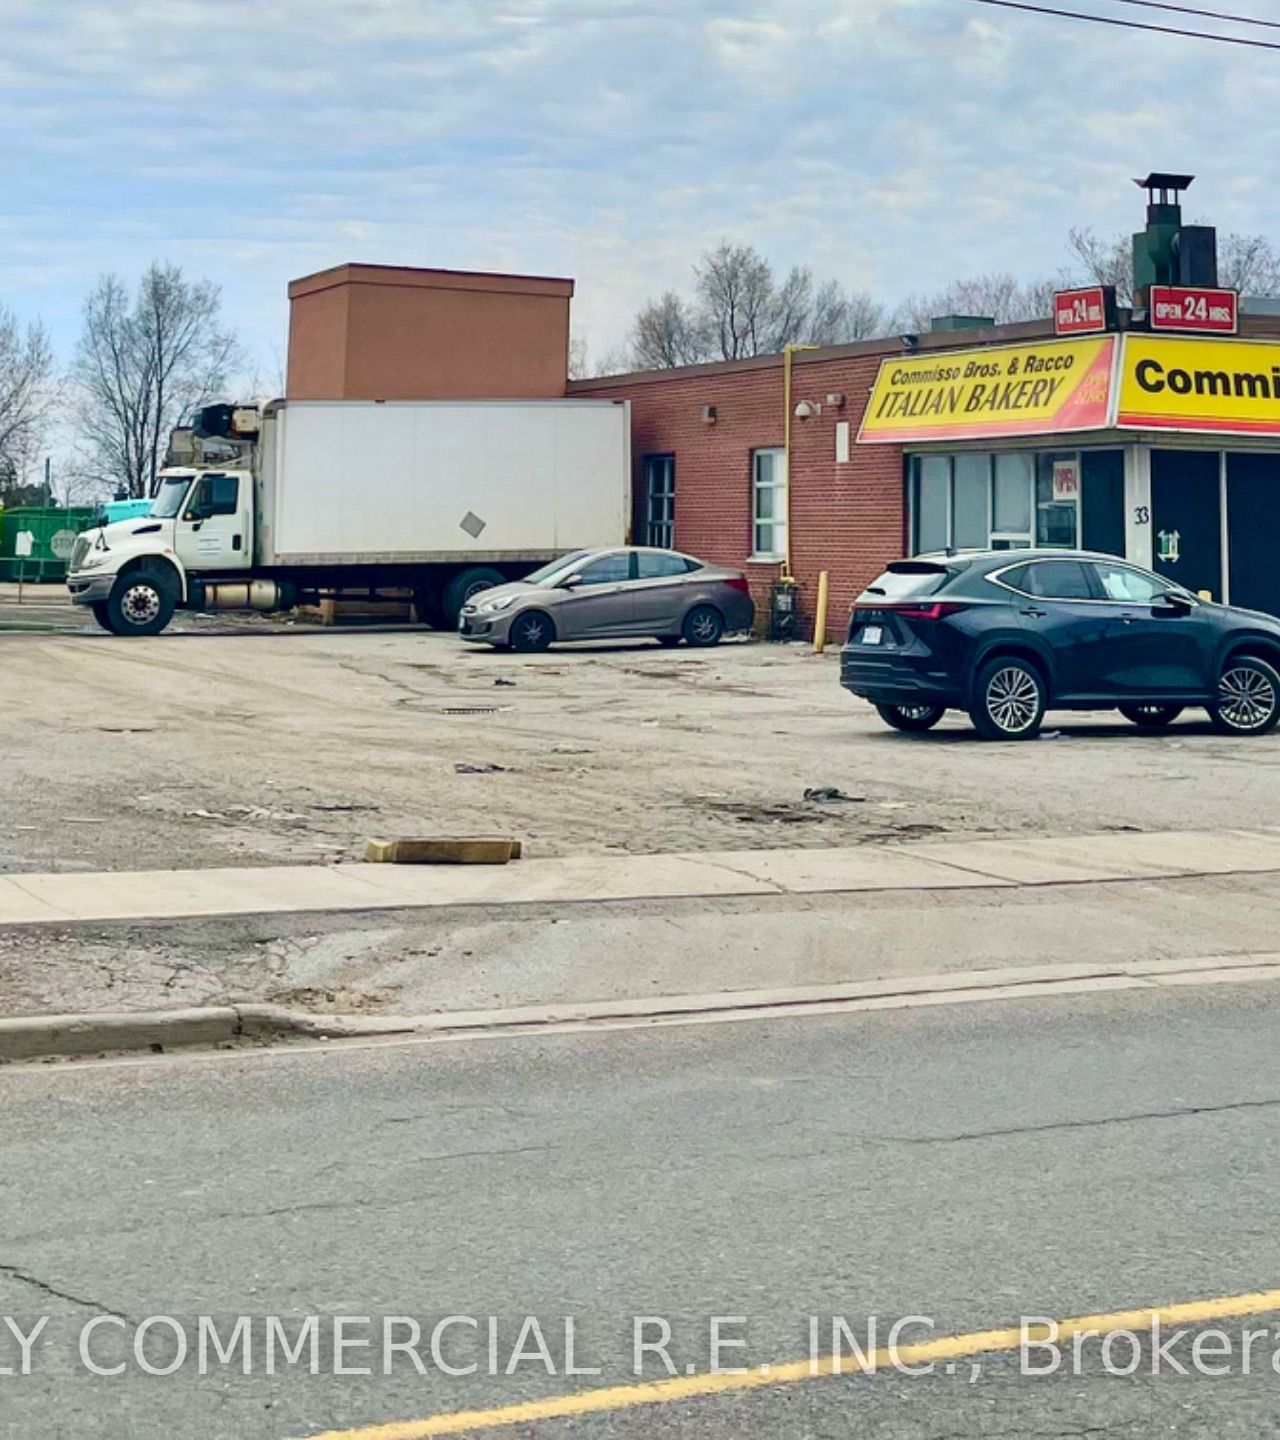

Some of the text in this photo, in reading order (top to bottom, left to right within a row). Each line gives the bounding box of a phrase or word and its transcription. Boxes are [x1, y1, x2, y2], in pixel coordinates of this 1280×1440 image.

[1073, 298, 1087, 322] 24
[1156, 296, 1231, 323] OPEN 24 HRS.
[890, 354, 1074, 386] Commisso Bros. & Racco
[876, 376, 1065, 419] ITALIAN BAKERY
[1134, 506, 1149, 525] 33
